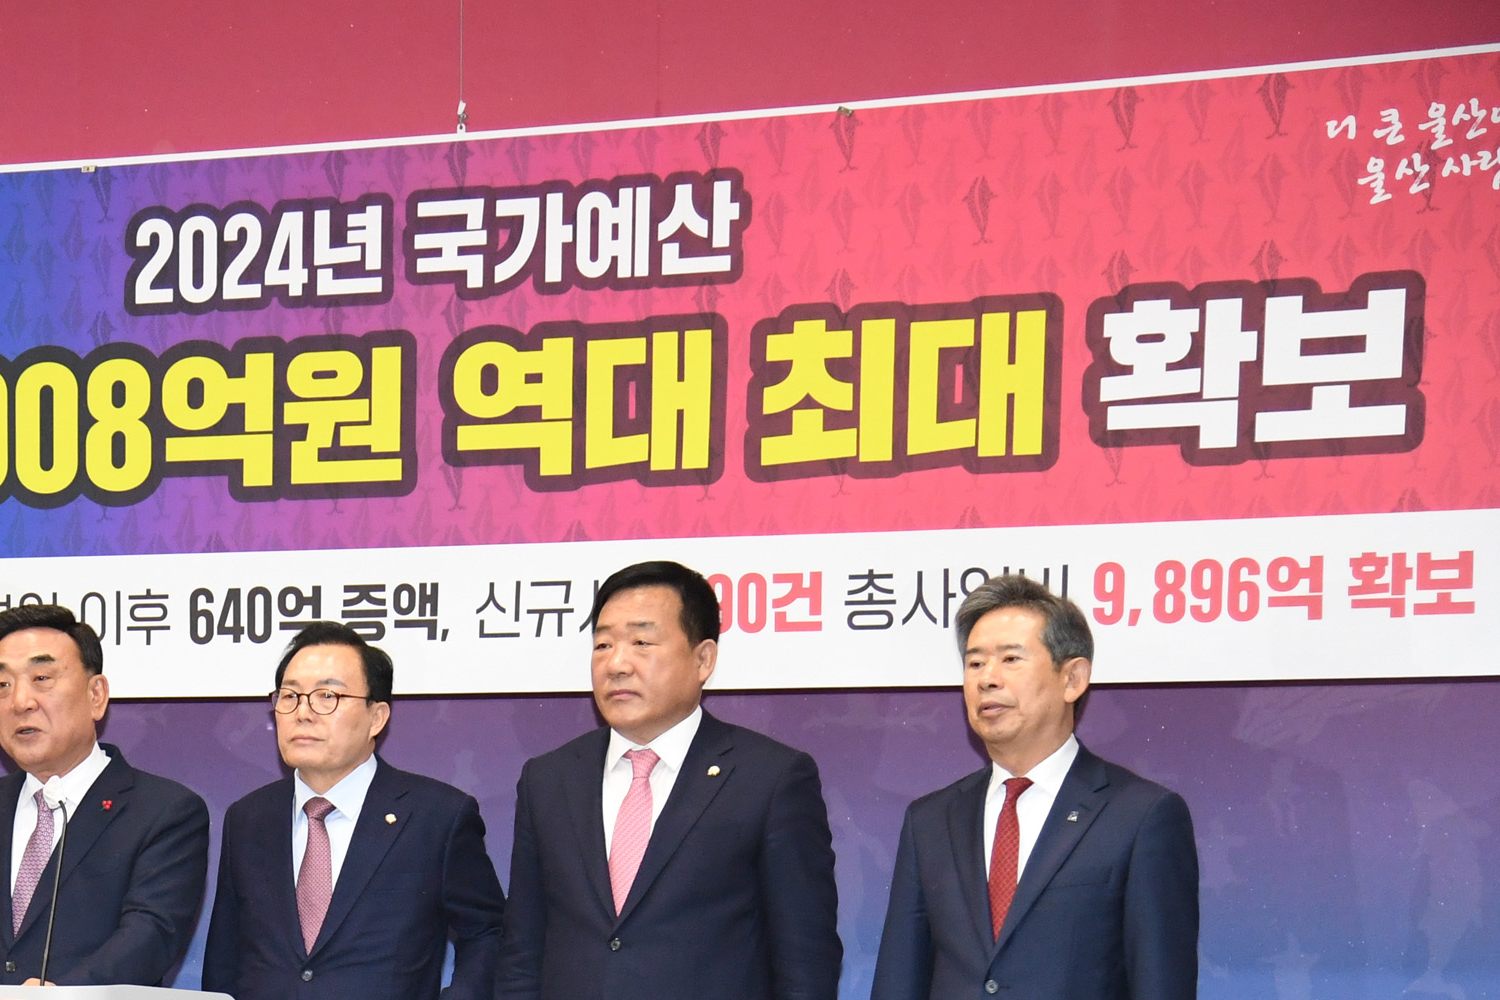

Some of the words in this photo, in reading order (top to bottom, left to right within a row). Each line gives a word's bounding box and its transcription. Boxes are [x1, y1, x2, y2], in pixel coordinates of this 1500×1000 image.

[1326, 115, 1357, 140] 더
[1373, 108, 1405, 145] 큰
[1357, 152, 1431, 205] 울산
[133, 204, 384, 306] 2024년
[413, 179, 741, 290] 국가예산
[452, 329, 713, 477] 역대
[759, 309, 1048, 467] 최대
[1099, 287, 1407, 450] 확보
[80, 588, 171, 646] 이후
[189, 585, 322, 645] 640억
[341, 581, 450, 642] 증액,
[1092, 555, 1325, 627] 9,896억
[1347, 550, 1475, 618] 확보
